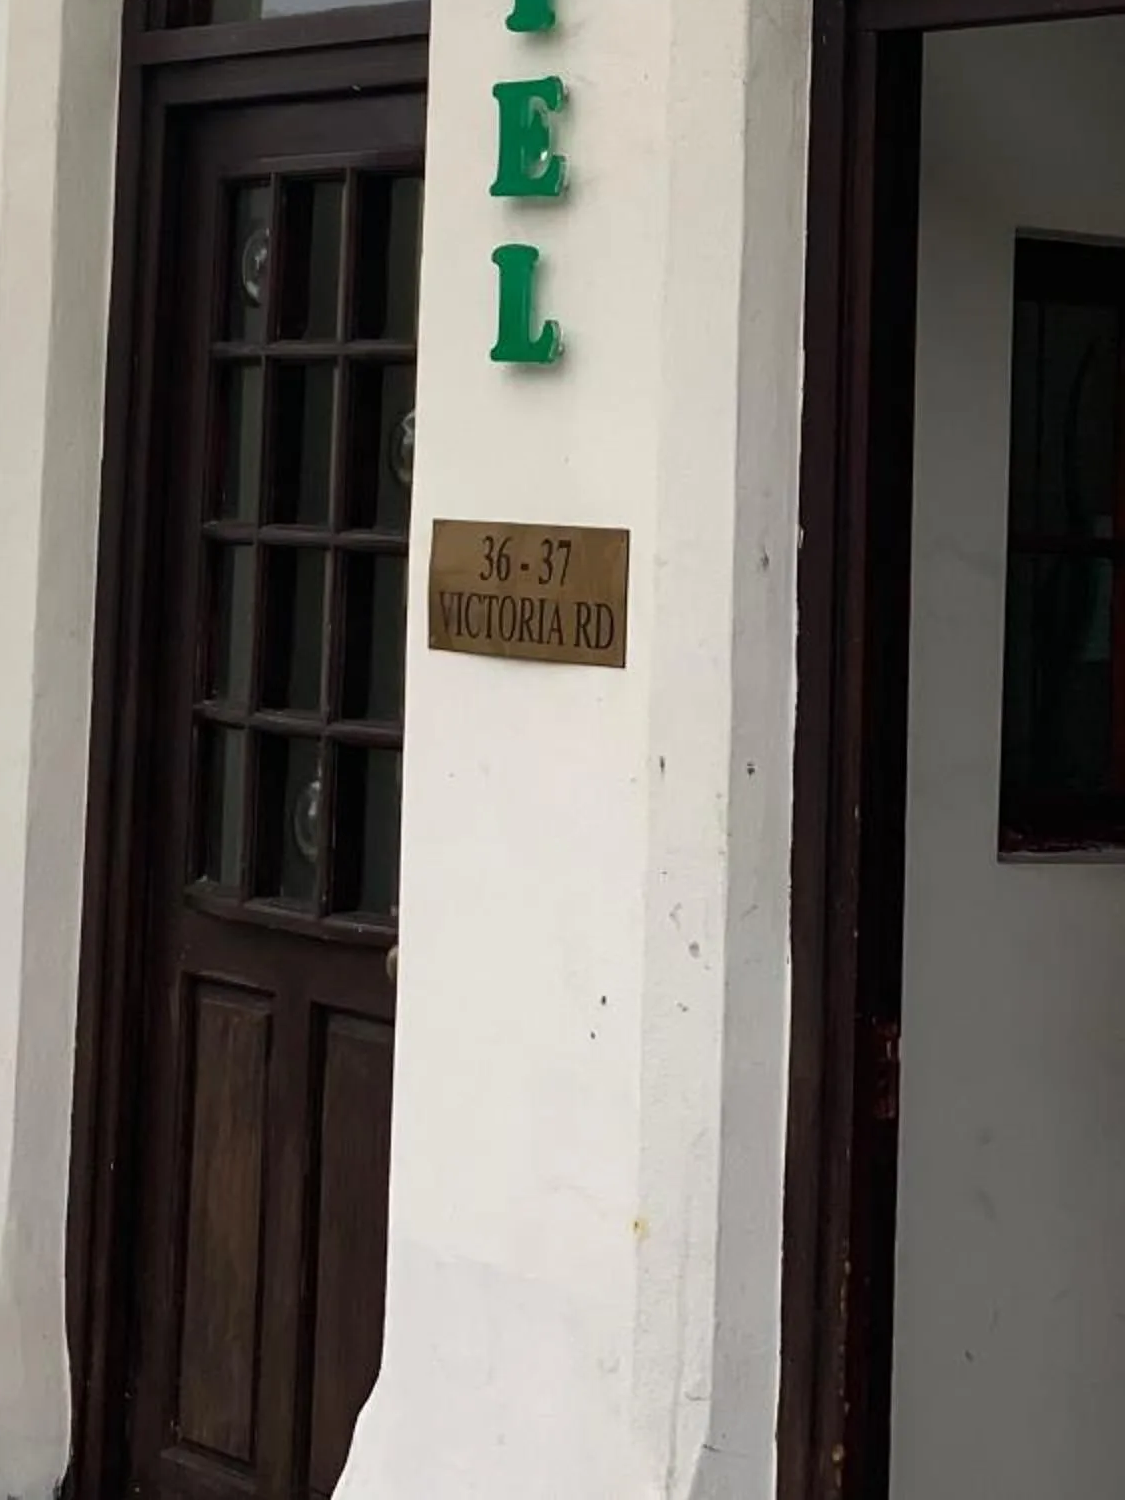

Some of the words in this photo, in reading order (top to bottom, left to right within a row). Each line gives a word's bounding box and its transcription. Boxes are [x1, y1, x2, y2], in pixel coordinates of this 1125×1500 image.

[479, 535, 512, 582] 36
[538, 539, 572, 586] 37
[439, 591, 564, 646] VICTORIA
[573, 602, 615, 649] RD
